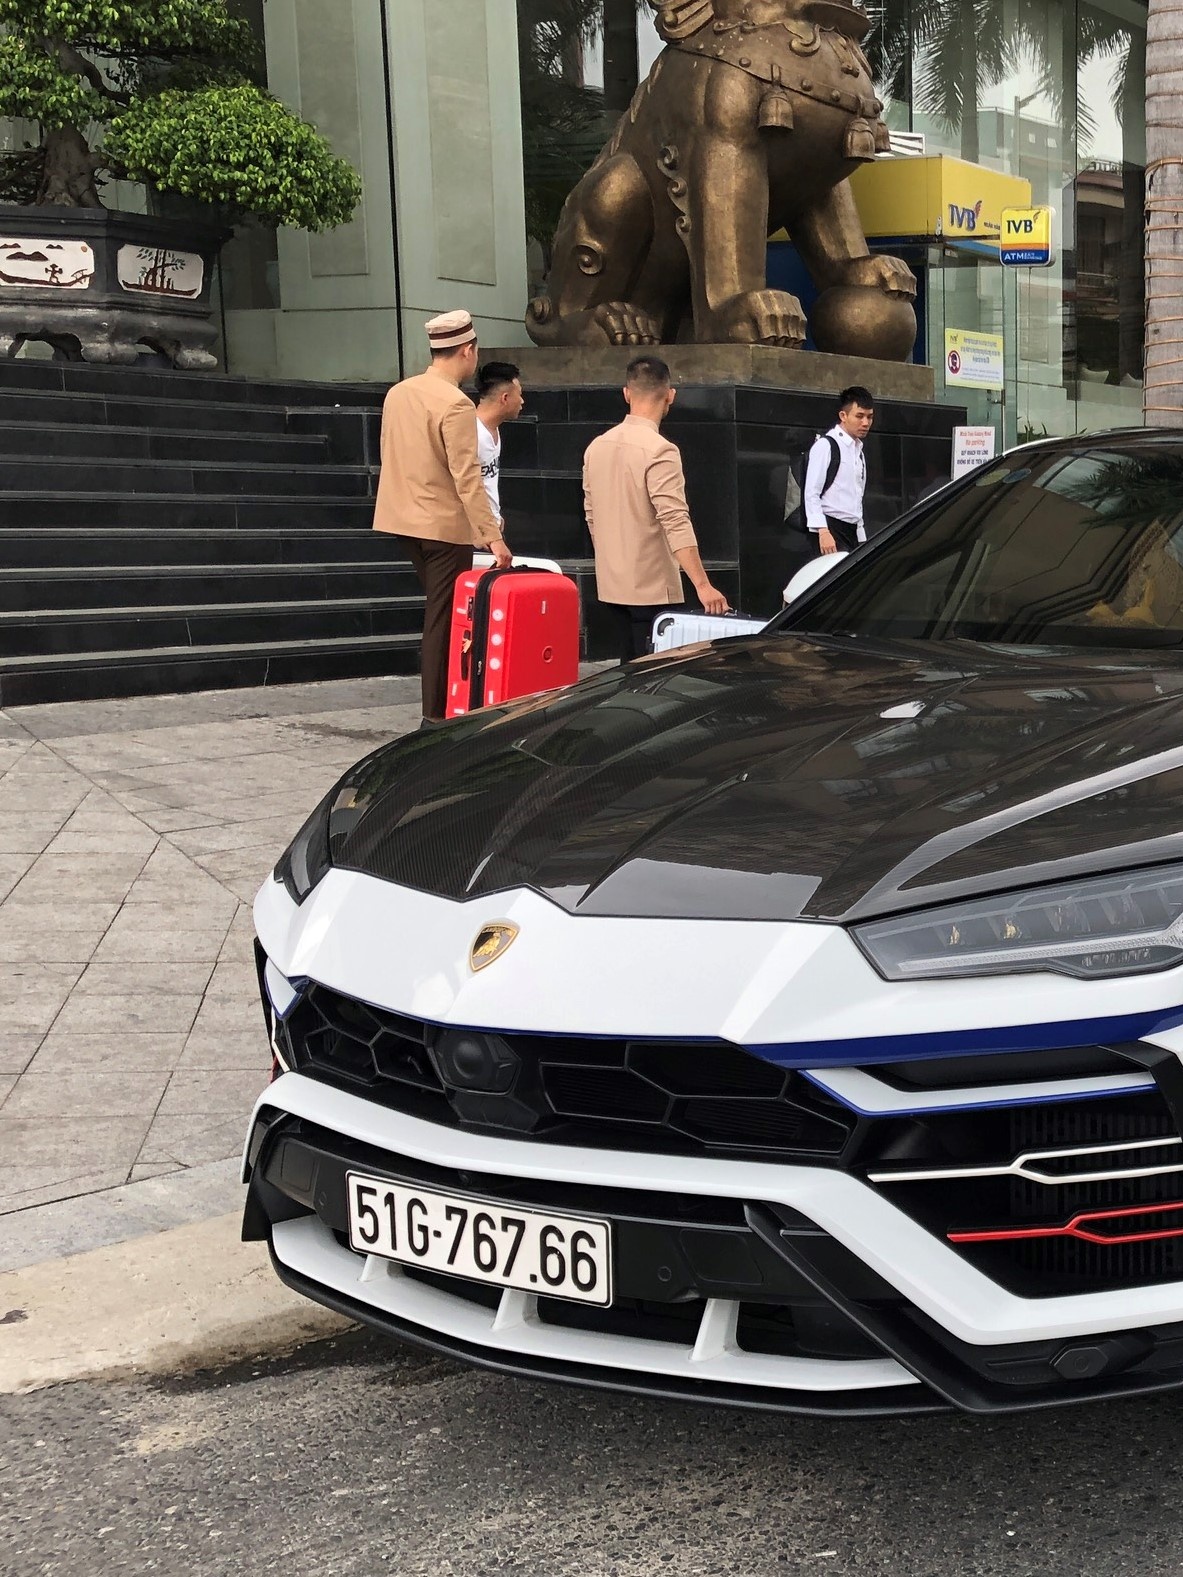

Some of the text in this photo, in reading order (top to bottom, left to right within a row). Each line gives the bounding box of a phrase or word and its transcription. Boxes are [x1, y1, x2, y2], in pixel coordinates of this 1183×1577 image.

[948, 203, 976, 232] IVB
[1006, 219, 1033, 234] IVB
[1004, 252, 1024, 261] ATM
[356, 1184, 598, 1293] 51G-767.66
